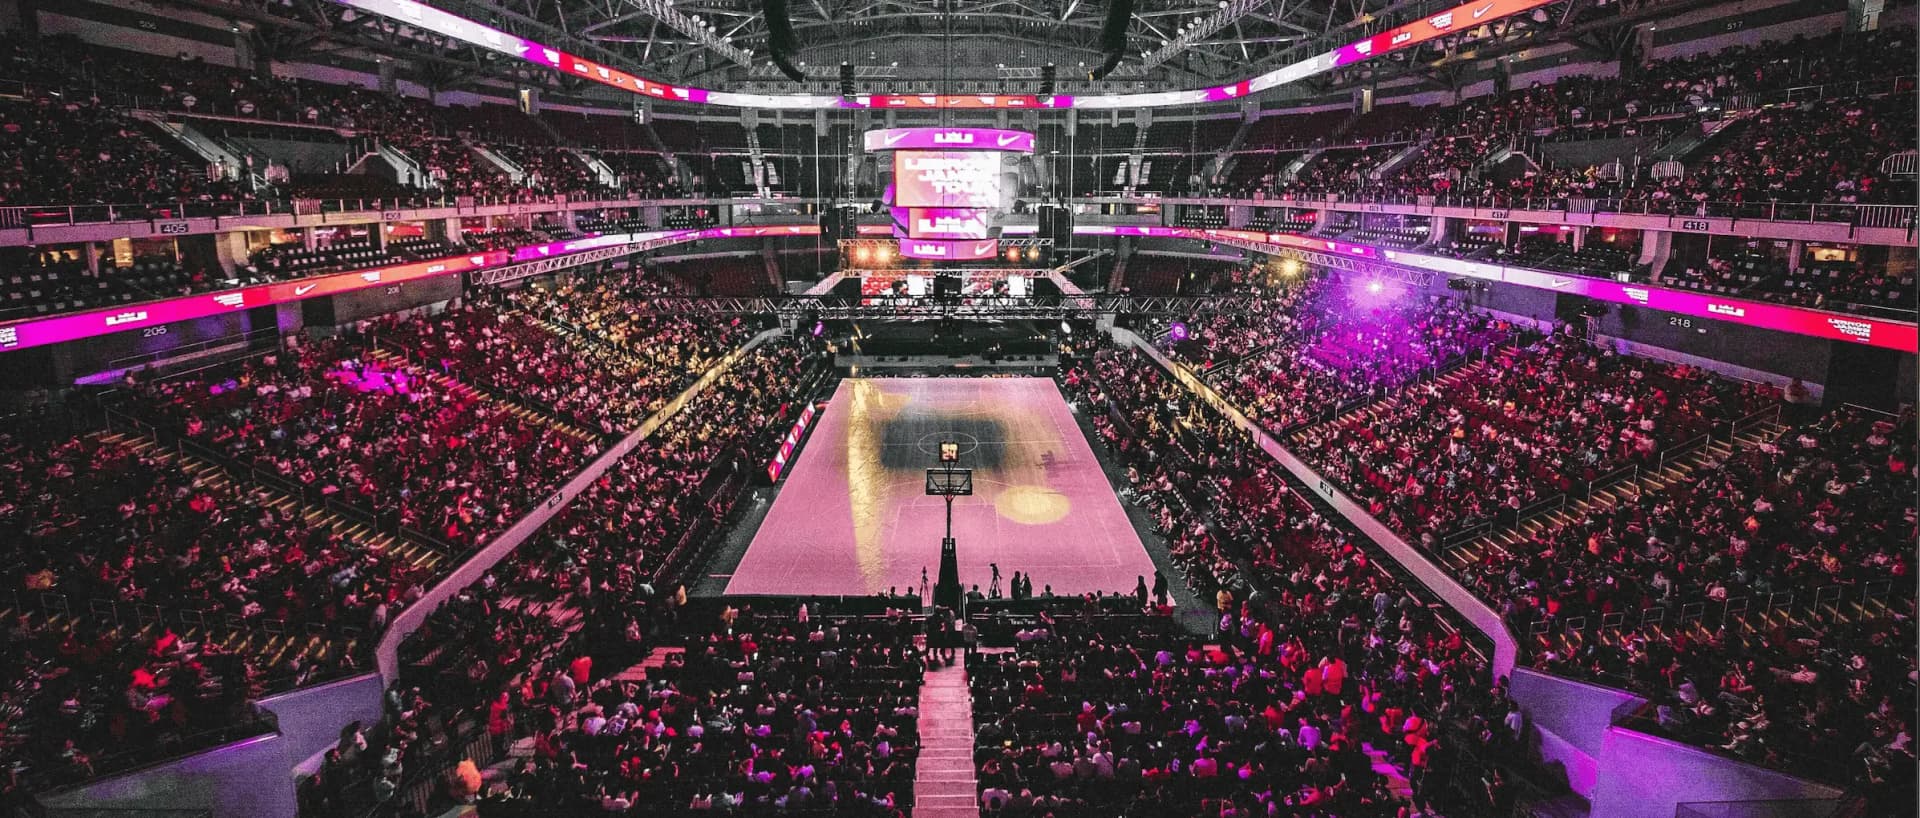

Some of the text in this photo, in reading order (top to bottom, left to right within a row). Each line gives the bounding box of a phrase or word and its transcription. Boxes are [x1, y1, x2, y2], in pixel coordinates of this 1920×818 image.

[163, 224, 186, 233] 405
[1684, 221, 1707, 231] 418
[1669, 316, 1691, 328] 218
[143, 325, 168, 337] 205
[1840, 328, 1871, 338] TOUR
